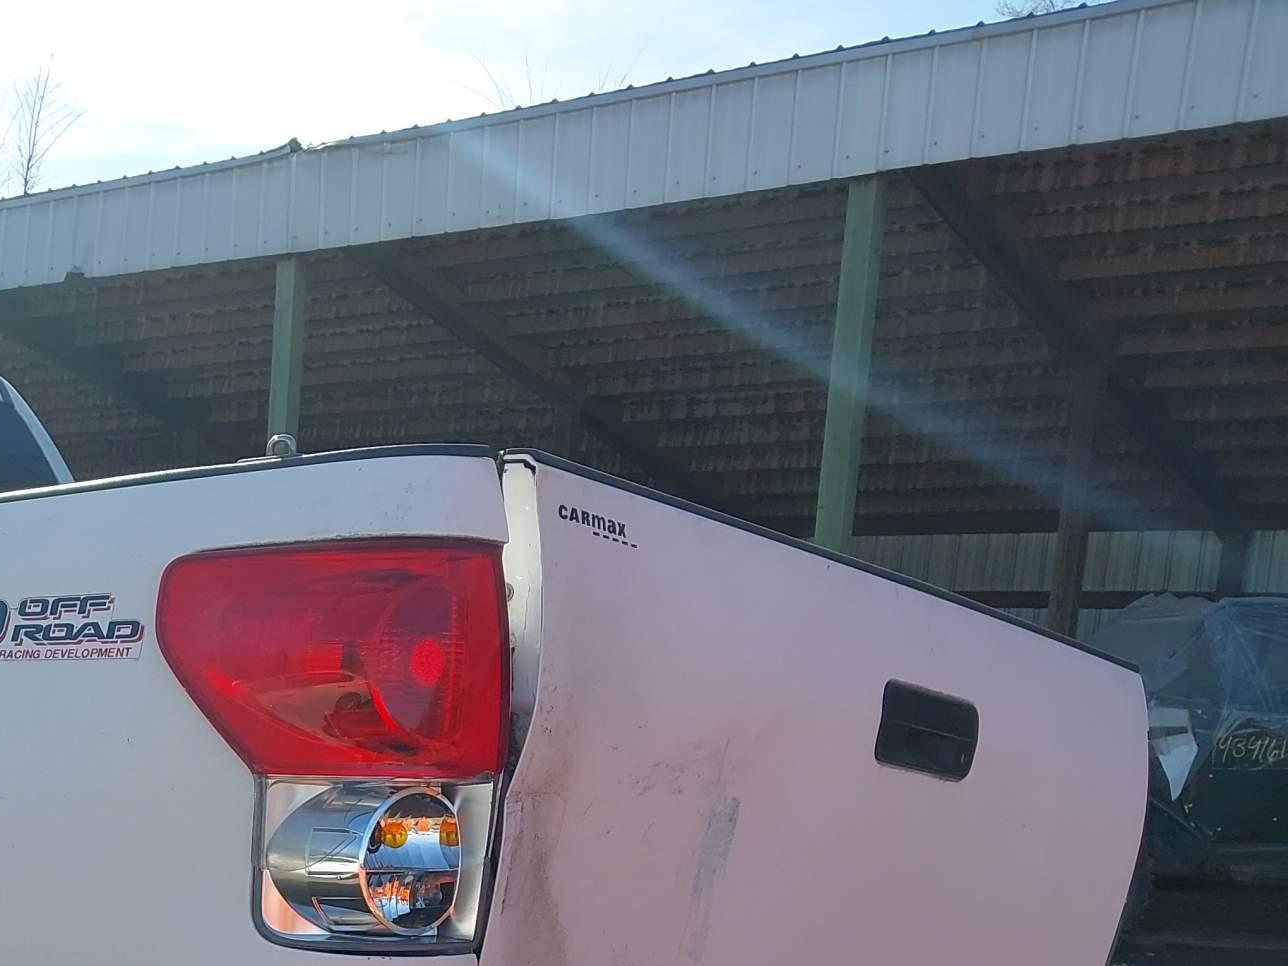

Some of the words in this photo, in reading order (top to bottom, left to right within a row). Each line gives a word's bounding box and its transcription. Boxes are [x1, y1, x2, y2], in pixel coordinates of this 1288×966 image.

[16, 594, 112, 621] OFF
[10, 620, 145, 647] ROAD
[44, 646, 133, 659] DEVELOPMENT
